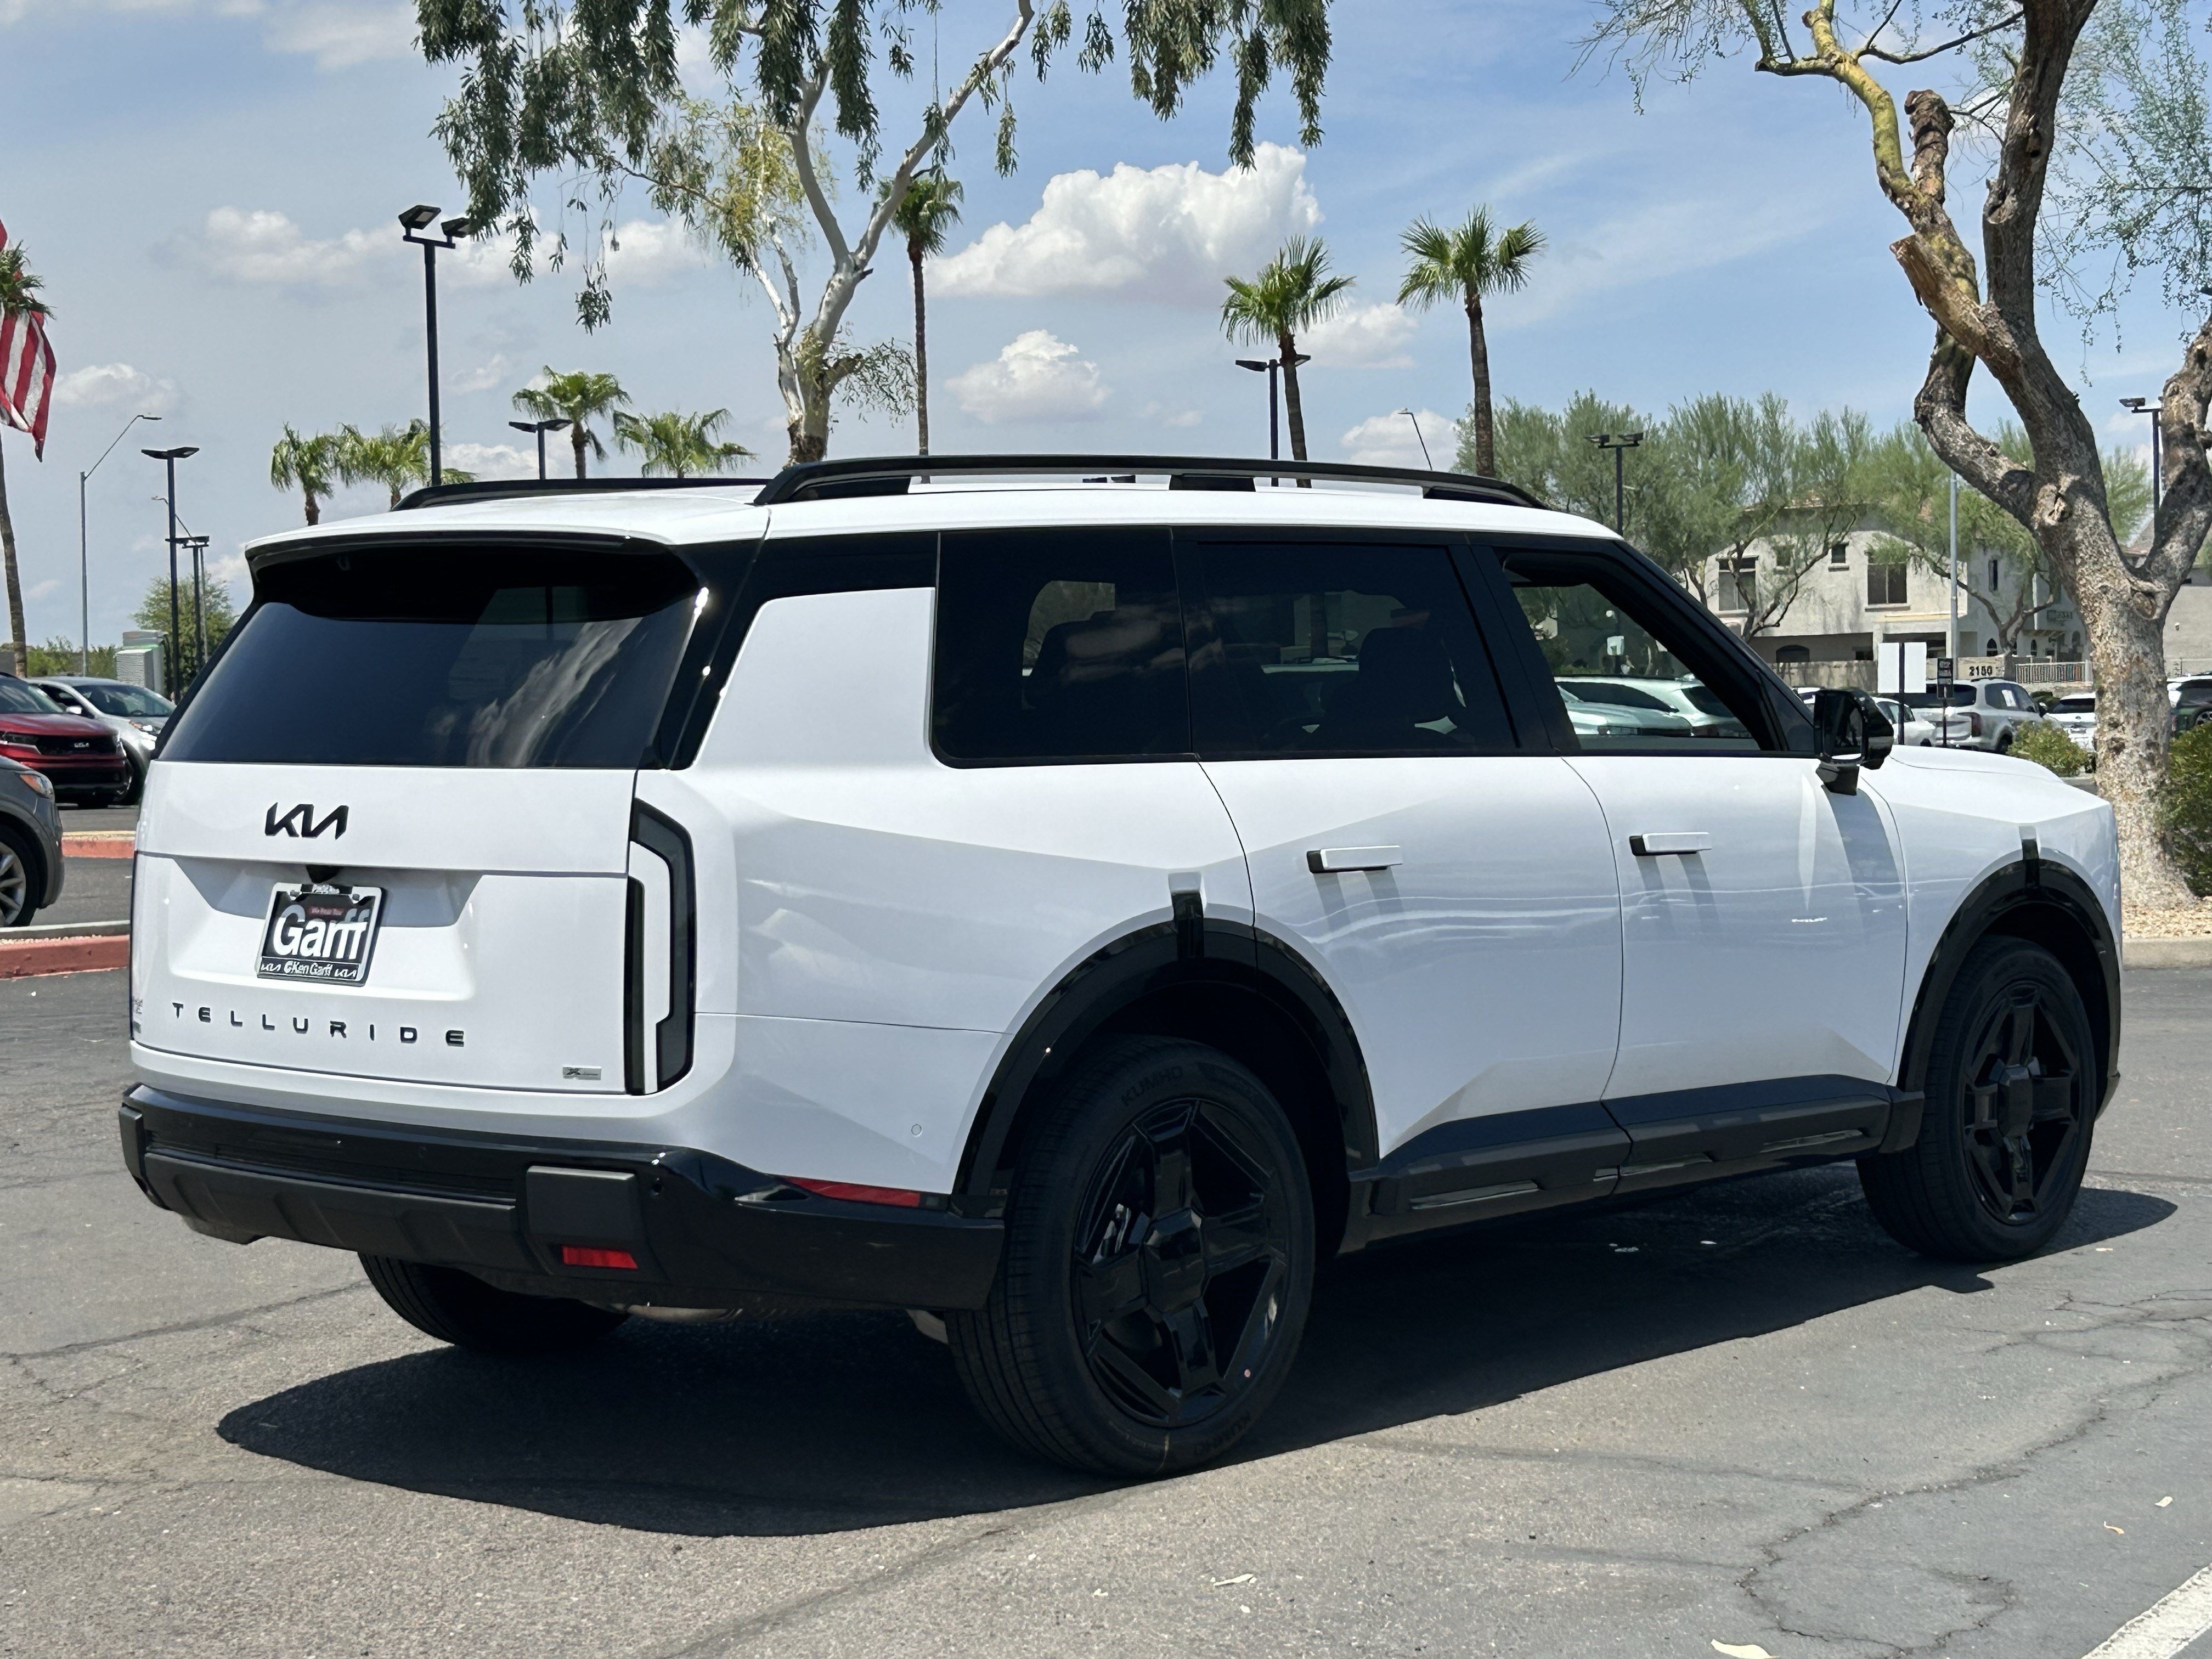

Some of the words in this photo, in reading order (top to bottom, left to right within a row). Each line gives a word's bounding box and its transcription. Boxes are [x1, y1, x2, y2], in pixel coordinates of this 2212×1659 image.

[264, 802, 349, 839] KIA
[273, 905, 370, 960] Garff
[173, 1003, 465, 1047] TELLURIDE
[1121, 1065, 1183, 1105] KUMHO
